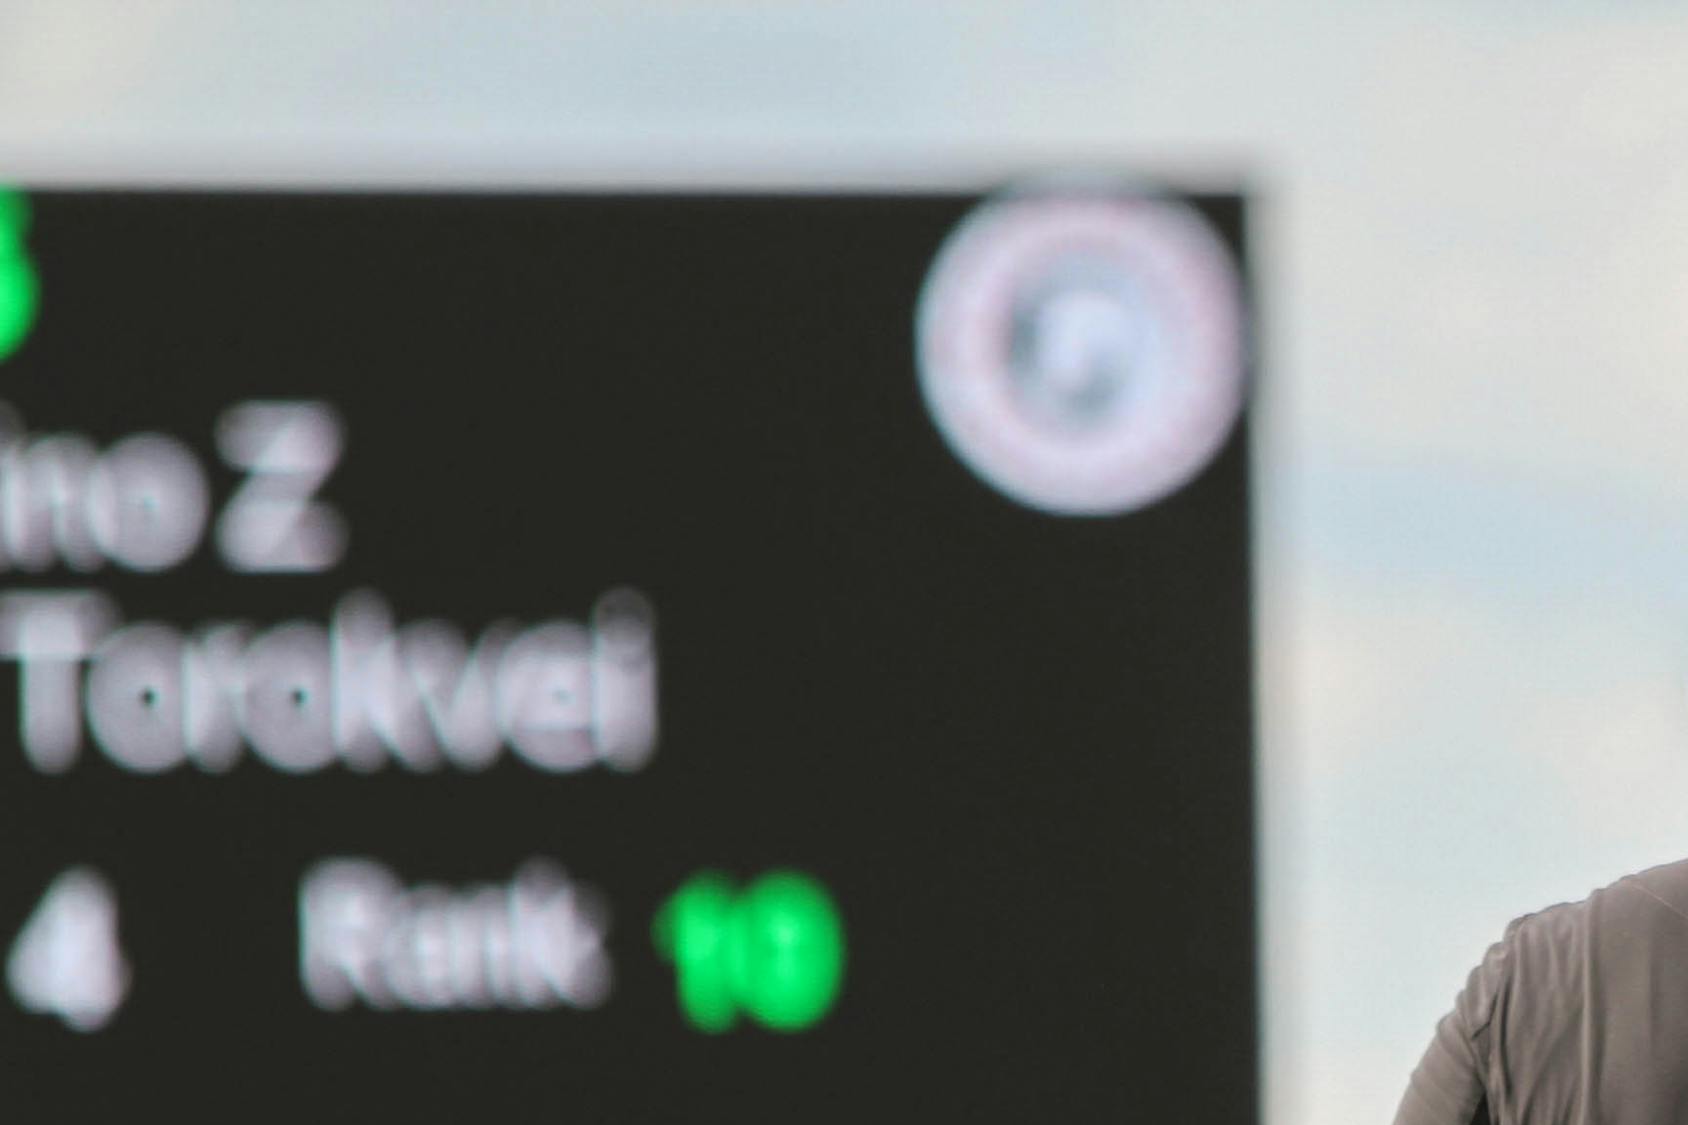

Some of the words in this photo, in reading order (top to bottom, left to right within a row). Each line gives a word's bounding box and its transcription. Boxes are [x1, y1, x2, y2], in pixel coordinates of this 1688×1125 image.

[215, 401, 341, 573] Z
[7, 869, 130, 1031] 4
[298, 859, 607, 1009] Rank
[655, 871, 845, 1031] 10
